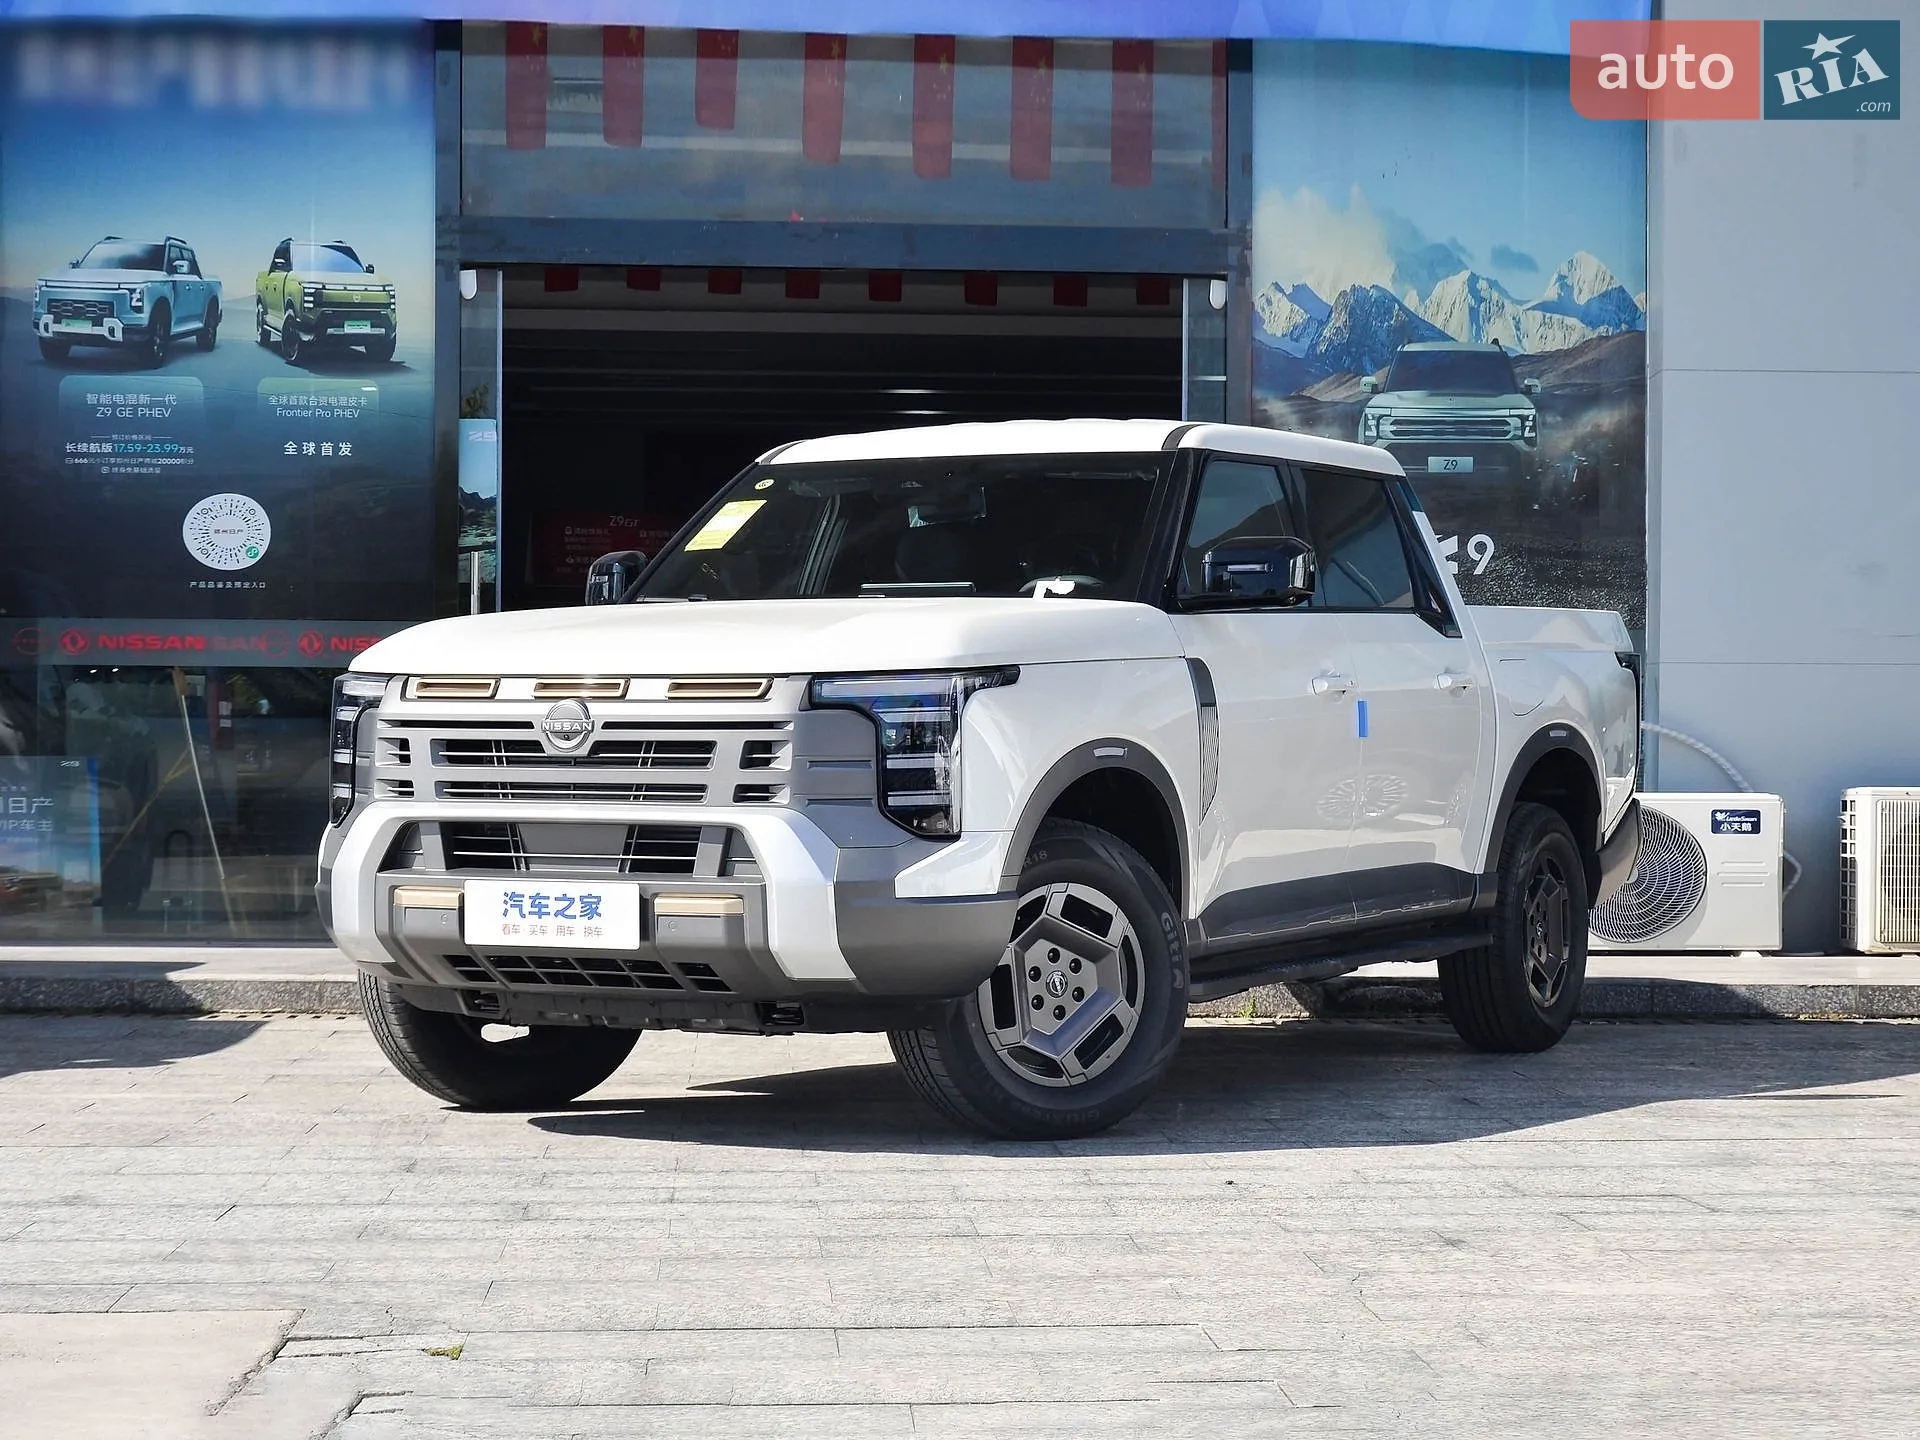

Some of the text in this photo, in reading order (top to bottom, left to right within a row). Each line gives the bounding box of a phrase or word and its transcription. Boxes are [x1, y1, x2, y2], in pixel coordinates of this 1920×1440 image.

[96, 407, 172, 418] Z9 GE PHEV
[276, 407, 360, 418] Frontier Pro PHEV
[283, 440, 353, 457] 全球首发
[1443, 459, 1458, 471] Z9
[98, 635, 206, 651] NISSAN
[541, 721, 593, 733] NISSAN
[502, 891, 602, 921] 汽车之家
